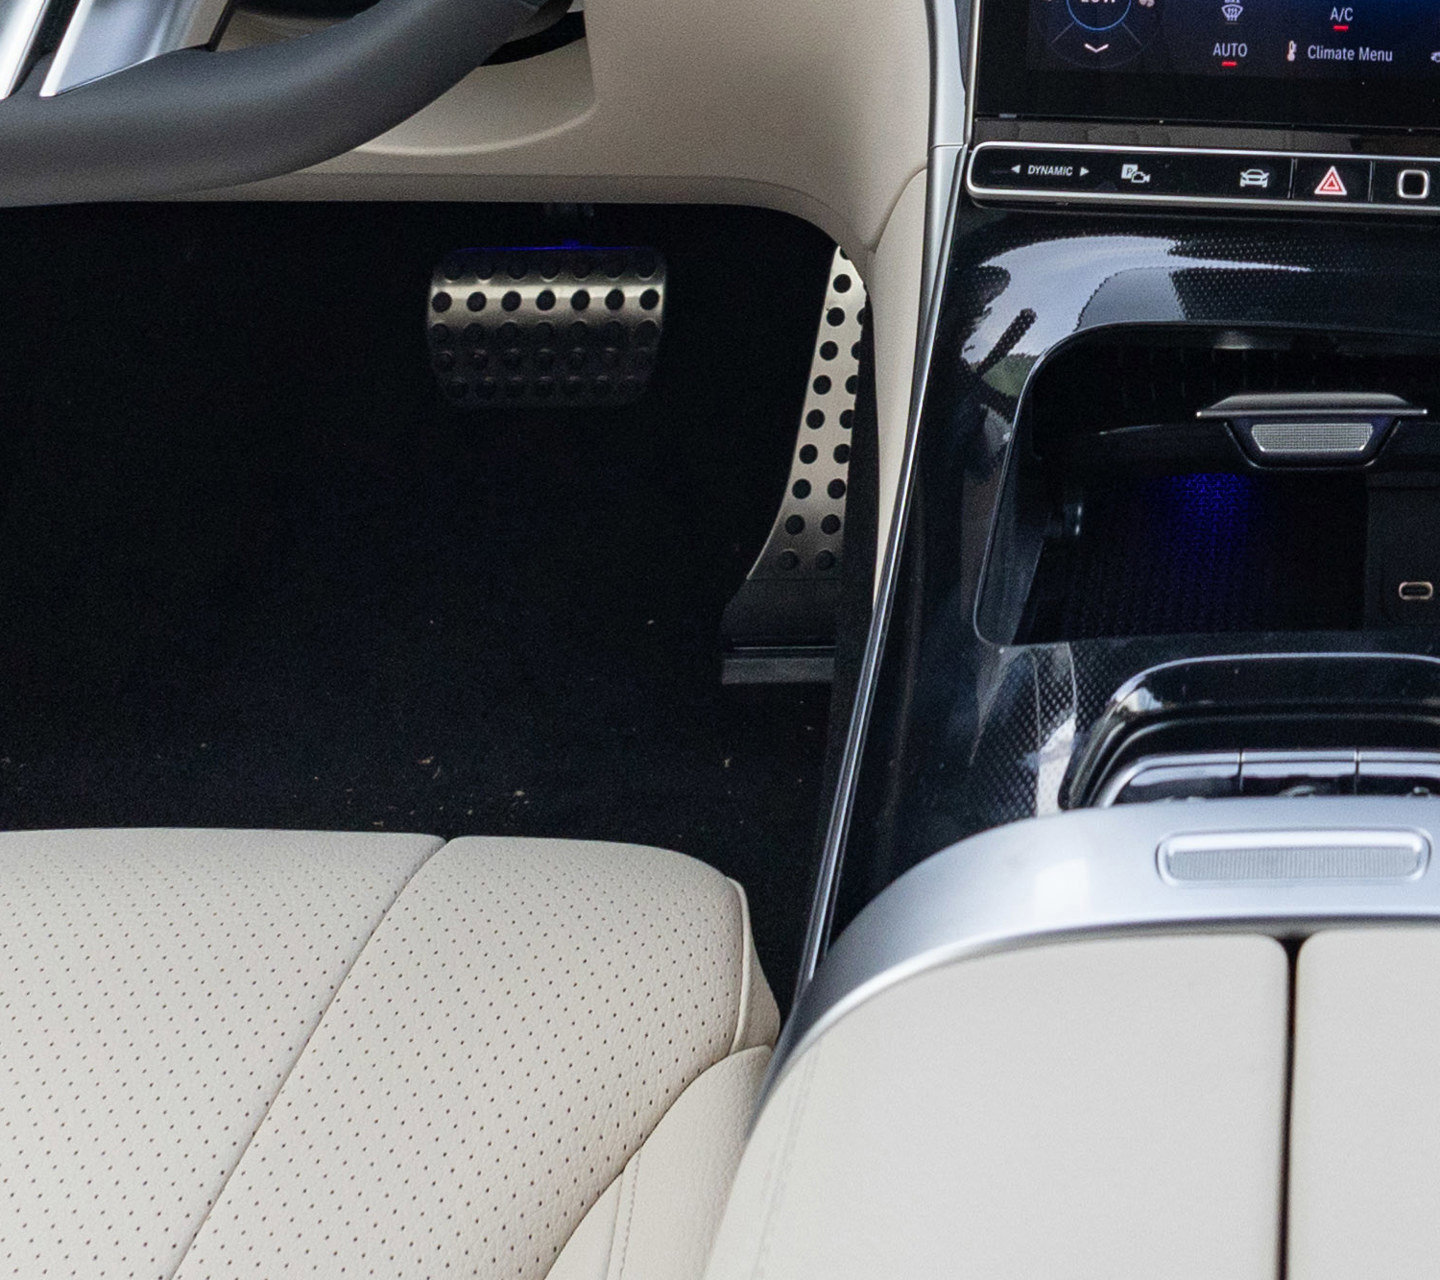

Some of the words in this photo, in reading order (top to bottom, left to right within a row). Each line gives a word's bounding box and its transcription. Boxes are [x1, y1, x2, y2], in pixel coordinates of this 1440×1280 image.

[1329, 6, 1354, 22] A/C
[1212, 42, 1248, 58] AUTO
[1307, 44, 1355, 61] Climate
[1358, 46, 1394, 62] Menu
[1027, 164, 1074, 177] DYNAMIC
